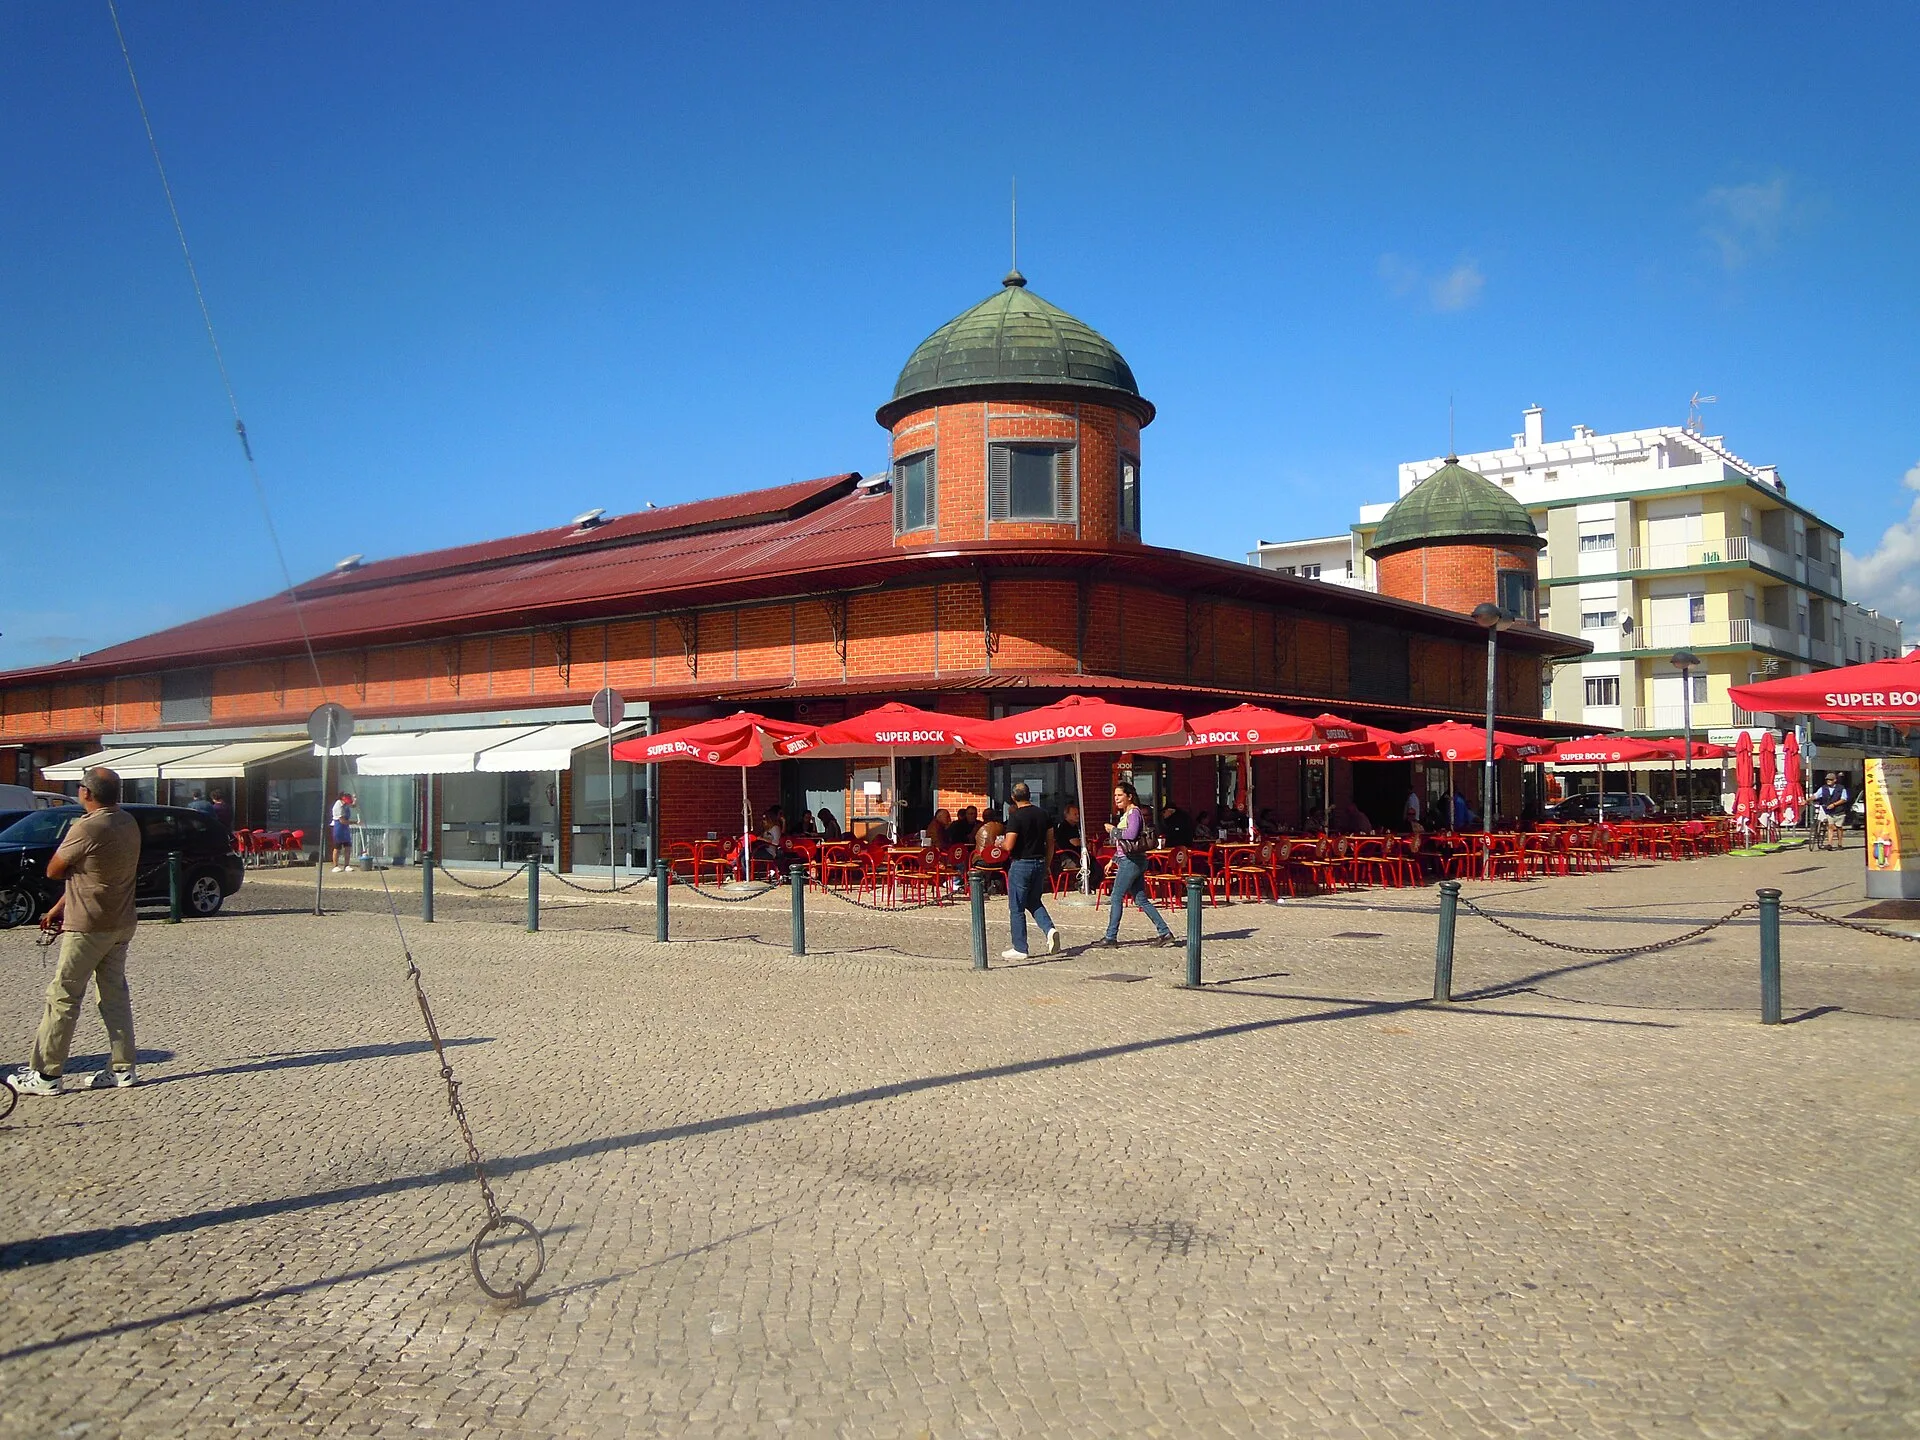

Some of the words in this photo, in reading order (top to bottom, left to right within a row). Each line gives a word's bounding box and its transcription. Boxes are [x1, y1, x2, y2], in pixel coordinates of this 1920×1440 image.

[1825, 692, 1886, 706] SUPER
[1889, 691, 1920, 706] BO
[875, 731, 911, 742] SUPER
[912, 730, 945, 741] BOCK
[1015, 728, 1055, 745] SUPER
[1056, 725, 1093, 739] BOCK
[1209, 731, 1240, 743] BOCK
[647, 742, 674, 756] SUPER
[674, 741, 701, 757] BOCK
[1560, 753, 1584, 761] SUPER
[1584, 752, 1607, 760] BOCK
